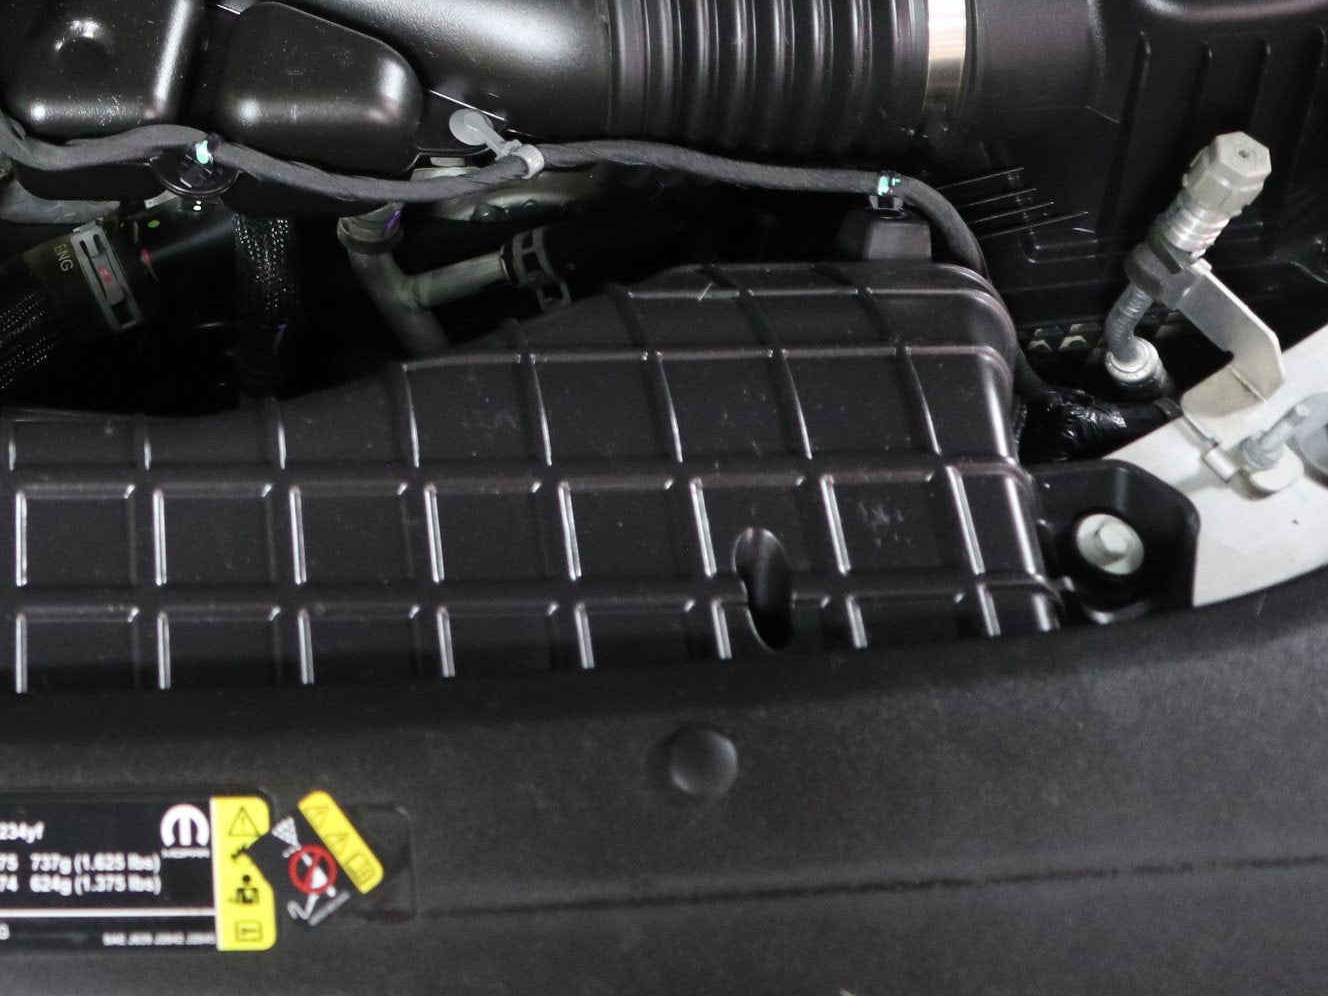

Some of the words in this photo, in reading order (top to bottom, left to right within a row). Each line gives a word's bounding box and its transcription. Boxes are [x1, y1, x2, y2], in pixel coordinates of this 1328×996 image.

[53, 243, 74, 272] ENG
[29, 853, 72, 874] 737g
[127, 853, 161, 874] lbs)
[74, 873, 126, 894] (1.375
[127, 873, 162, 894] lbs)
